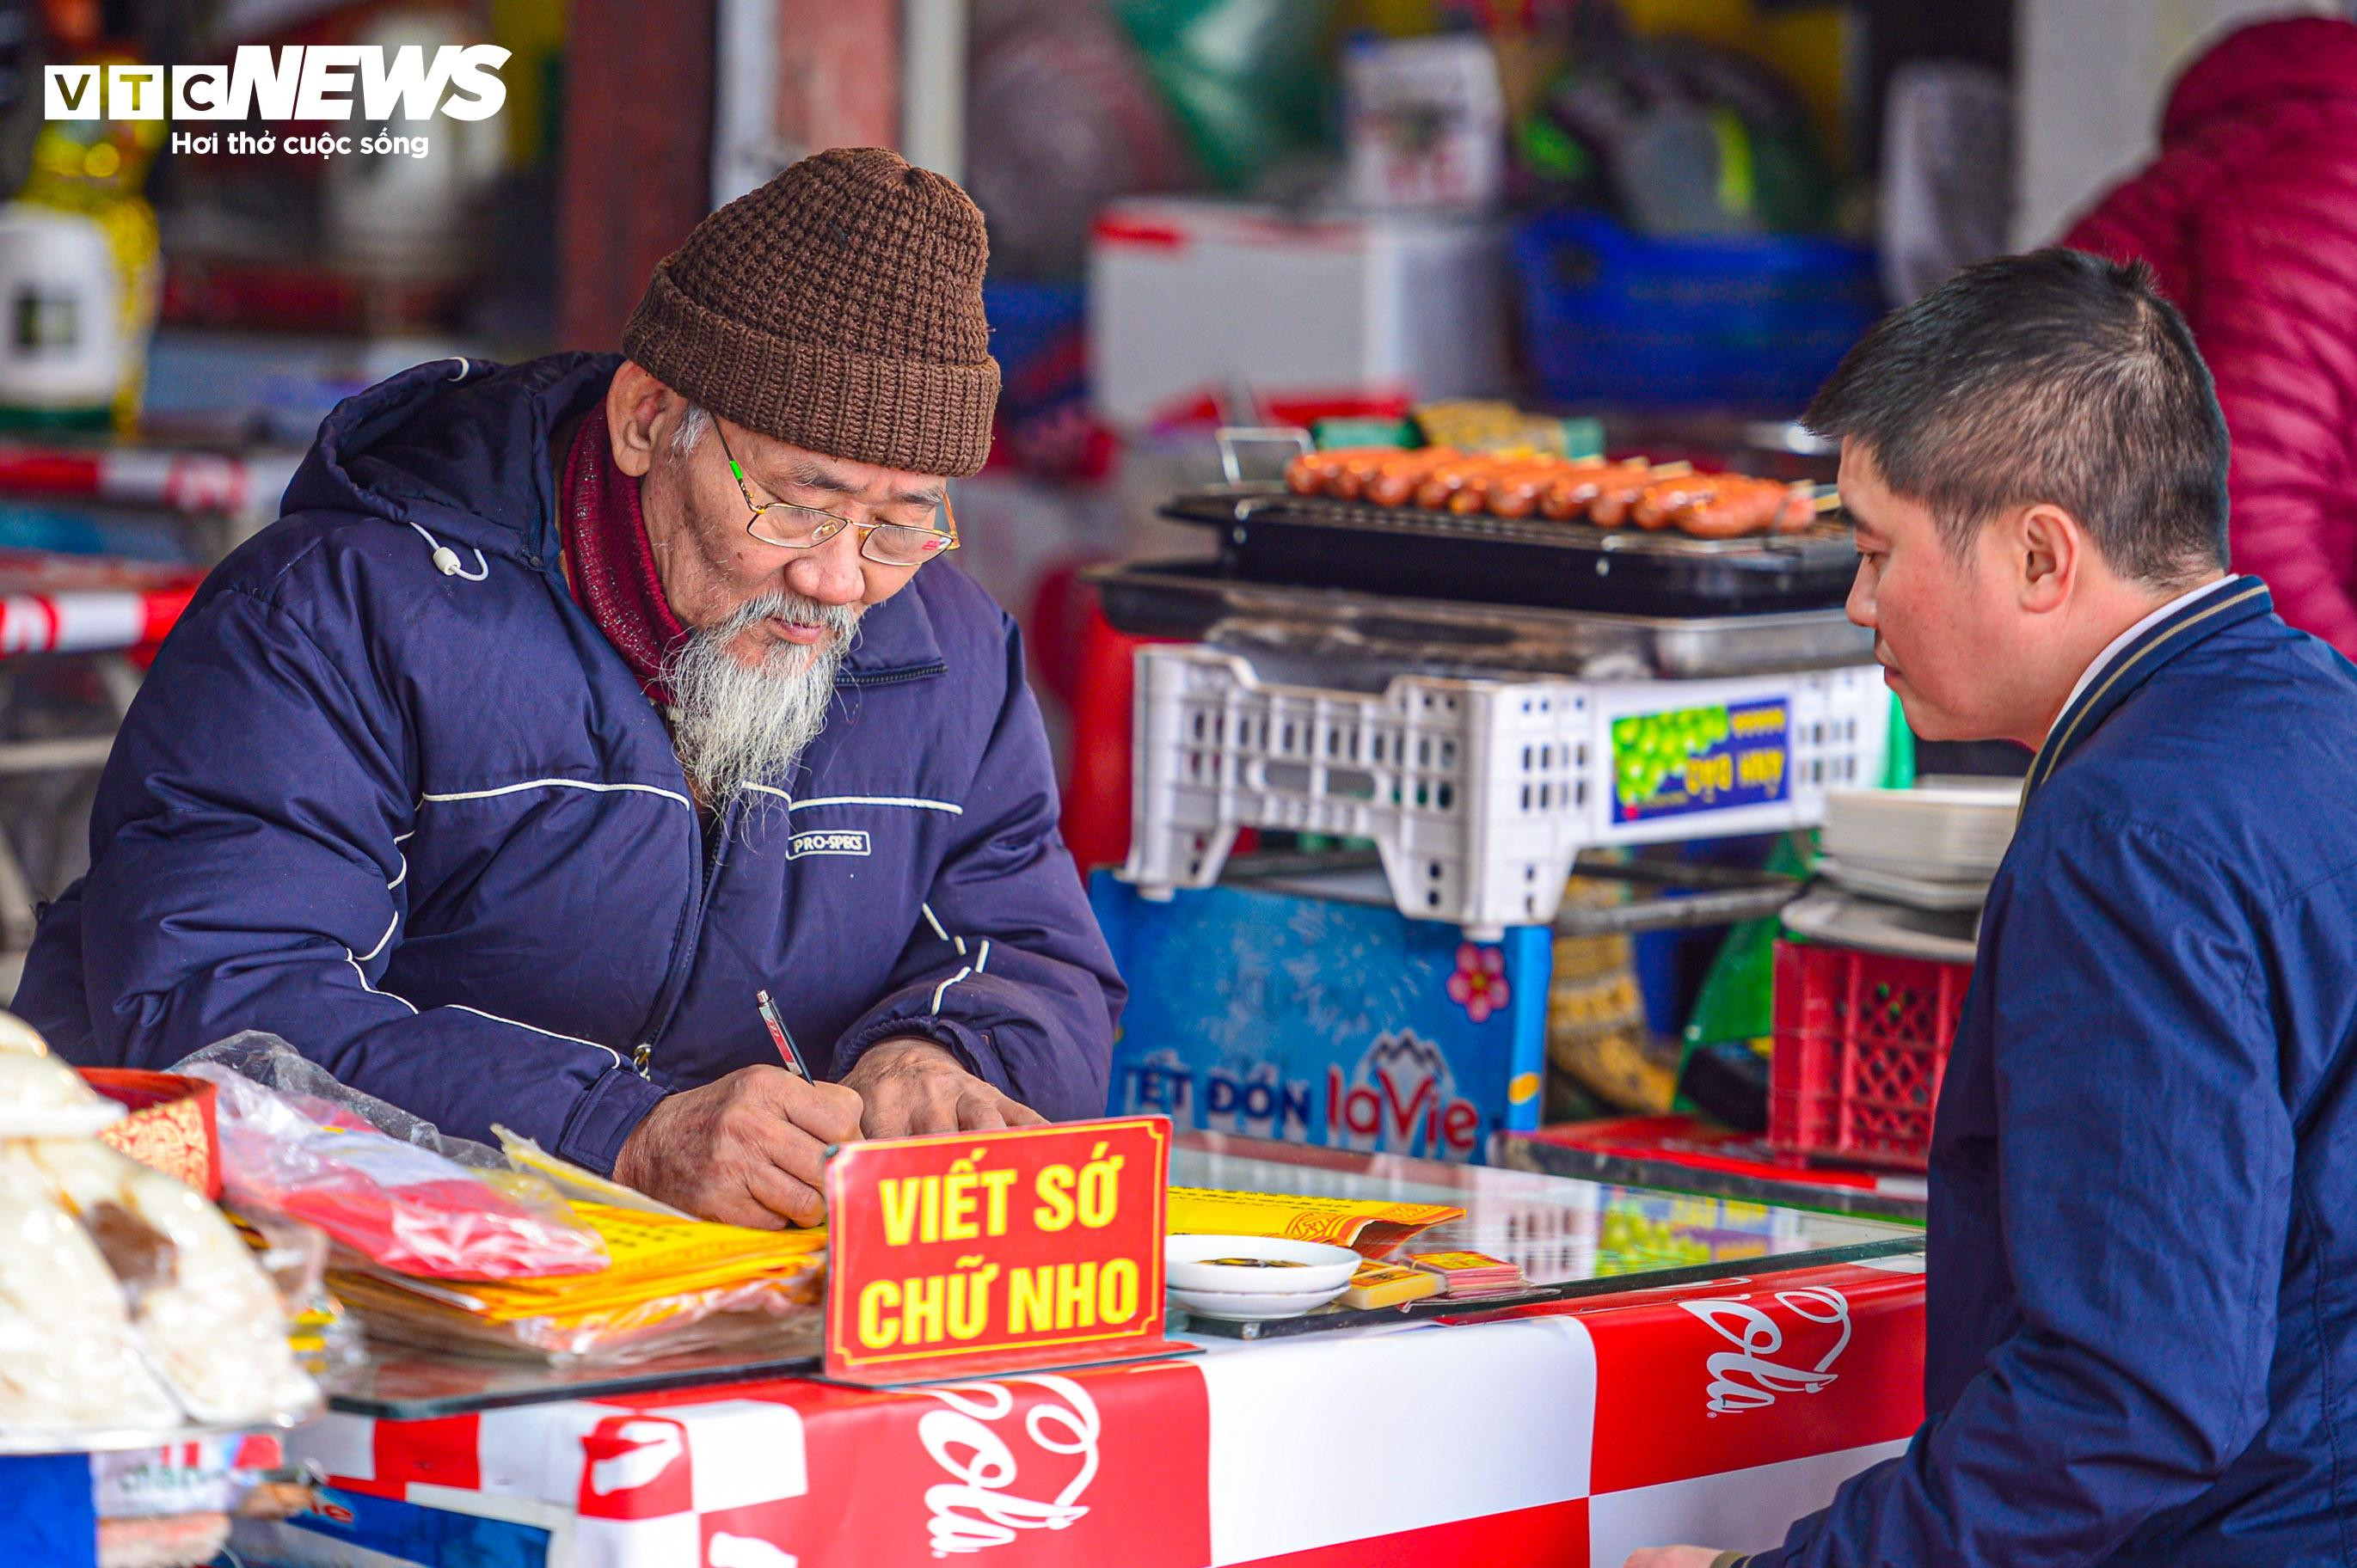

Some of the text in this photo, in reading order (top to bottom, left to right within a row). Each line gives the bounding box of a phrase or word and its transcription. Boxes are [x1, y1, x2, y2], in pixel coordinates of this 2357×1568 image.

[793, 835, 863, 854] PRO-SPECS
[1206, 1063, 1313, 1127] ĐÓN
[878, 1141, 1126, 1246] VIẾT SỚ
[857, 1253, 1140, 1350] CHỮ NHO
